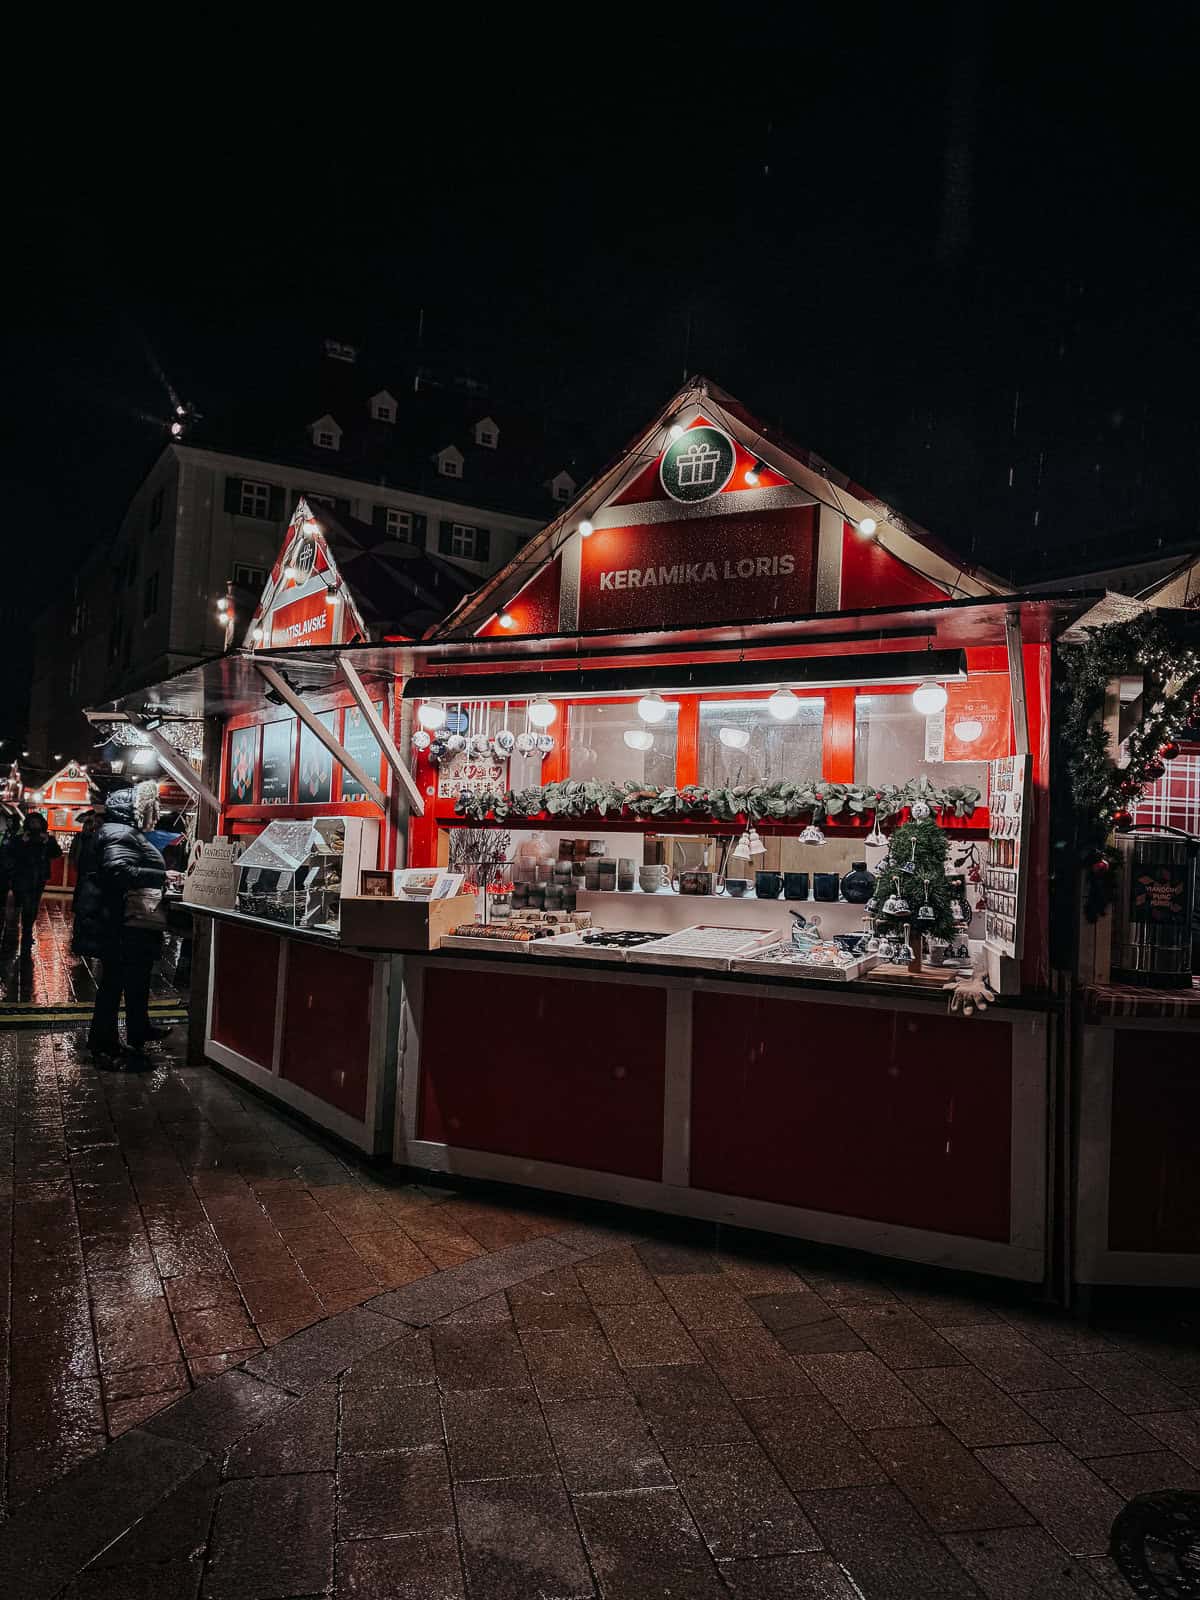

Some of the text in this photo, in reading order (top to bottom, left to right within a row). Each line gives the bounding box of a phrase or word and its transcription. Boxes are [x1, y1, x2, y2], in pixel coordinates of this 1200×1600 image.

[599, 554, 795, 591] KERAMIKA LORIS
[275, 609, 327, 643] ATISLAVSKÉ
